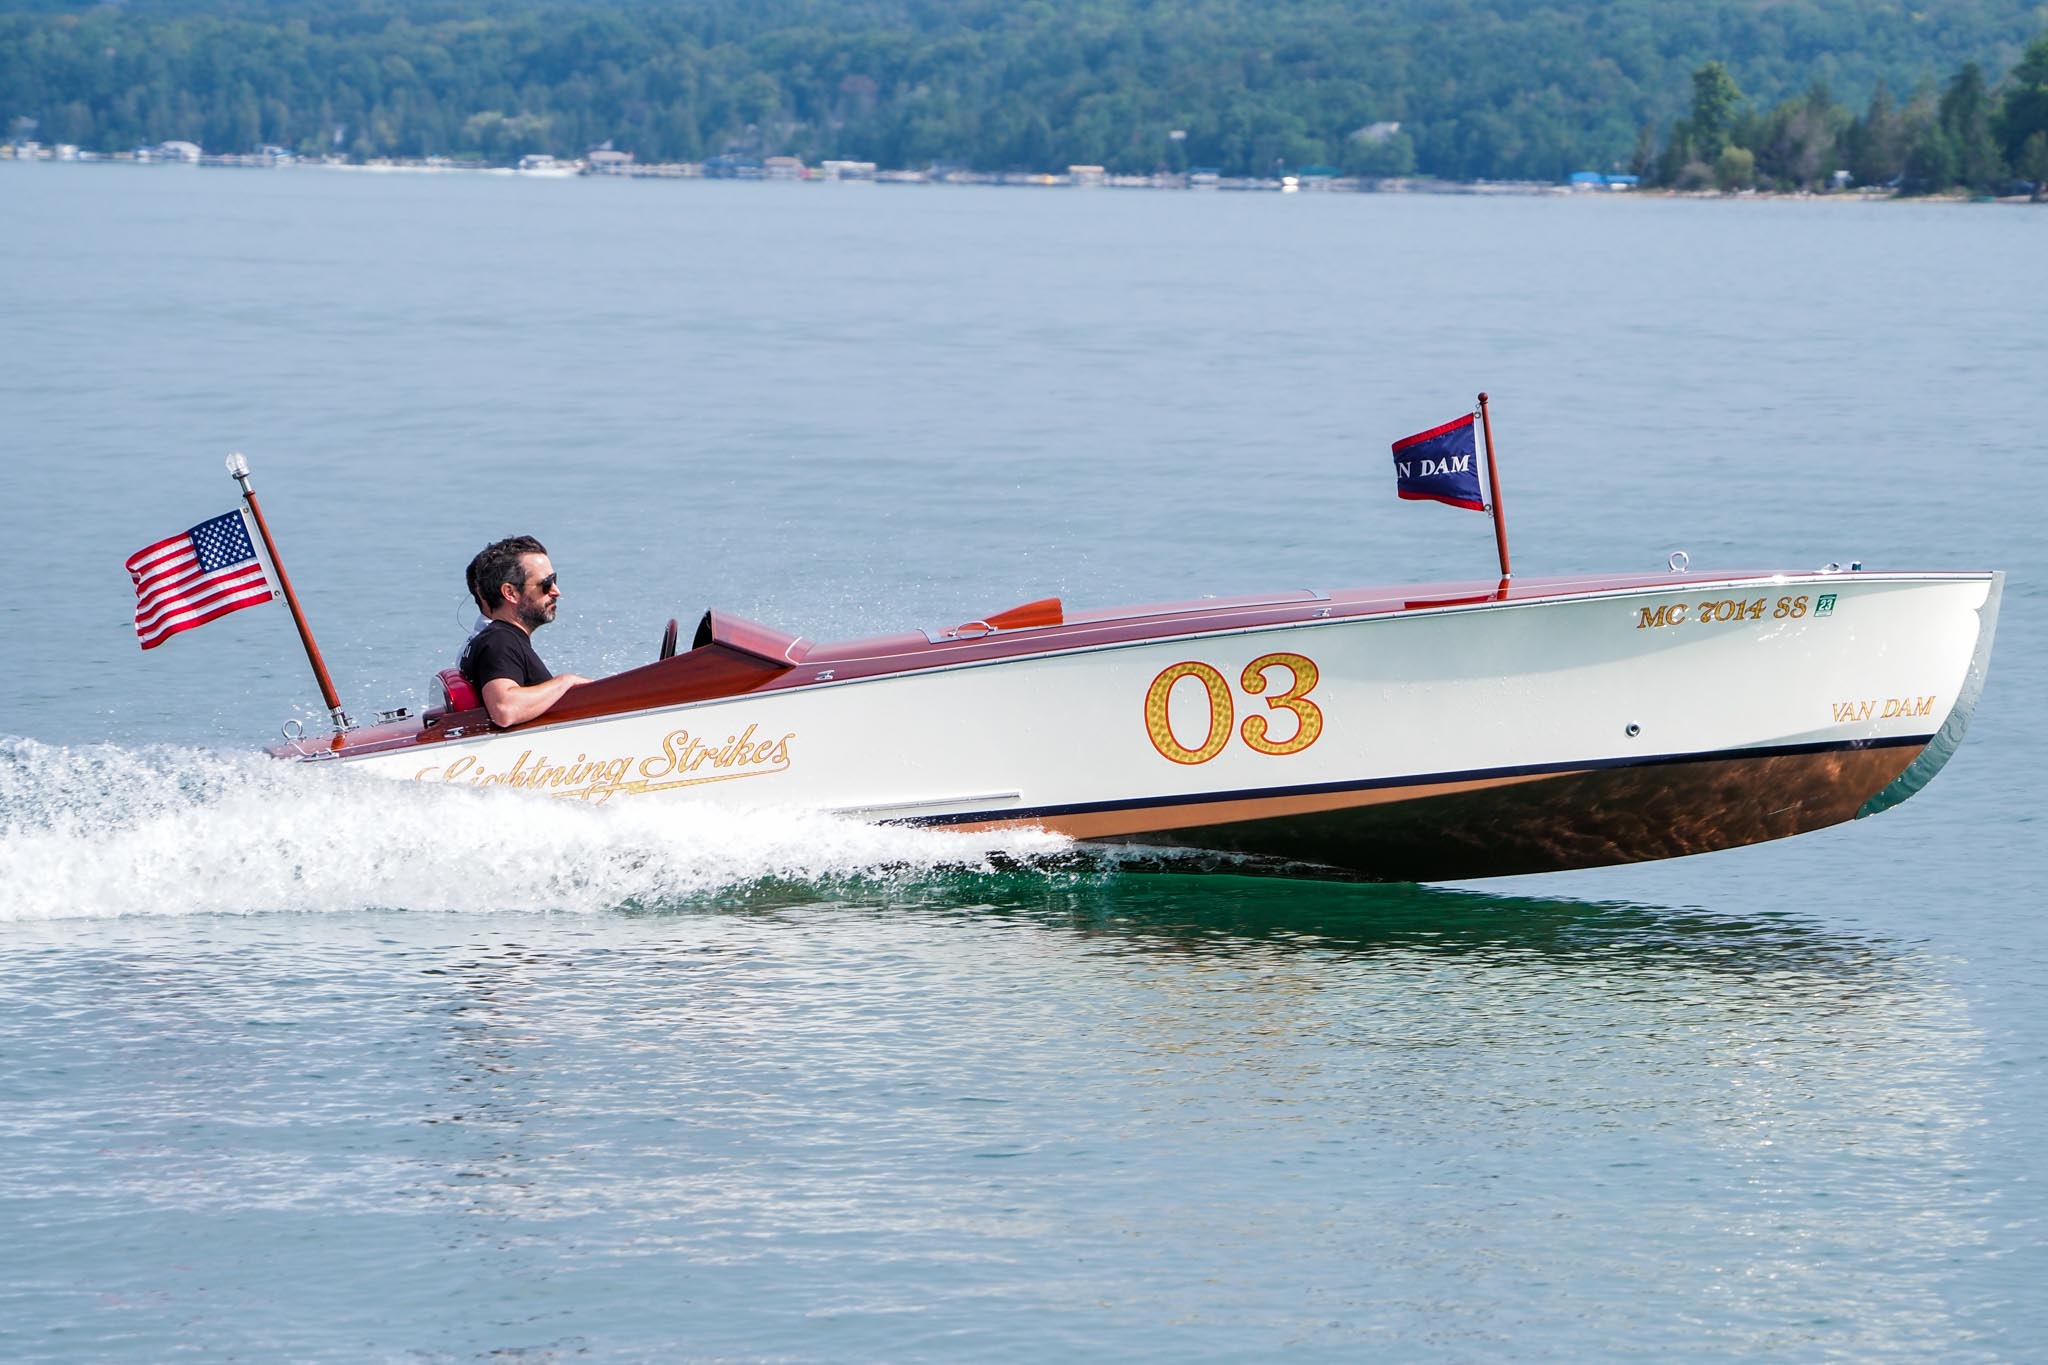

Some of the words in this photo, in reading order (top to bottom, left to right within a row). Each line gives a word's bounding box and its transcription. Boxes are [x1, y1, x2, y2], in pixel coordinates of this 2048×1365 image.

[1420, 454, 1470, 477] DAM
[1637, 604, 1688, 629] MC
[1698, 598, 1767, 624] 7014
[1773, 596, 1809, 619] SS
[1818, 599, 1833, 611] 23
[1144, 652, 1323, 765] 03
[1832, 701, 1877, 723] VAN
[1880, 695, 1936, 719] DAM
[639, 723, 797, 777] Strikes
